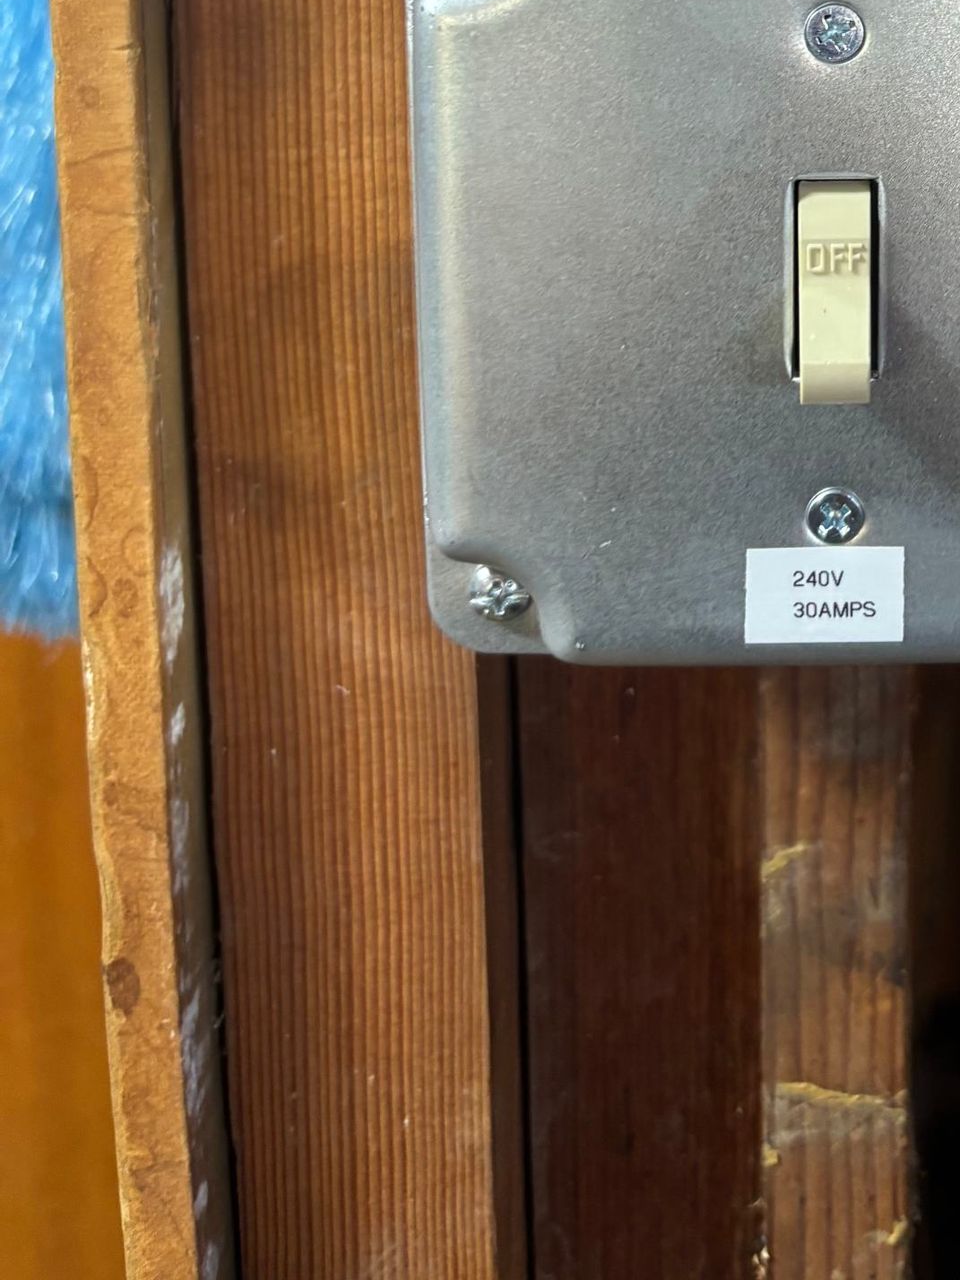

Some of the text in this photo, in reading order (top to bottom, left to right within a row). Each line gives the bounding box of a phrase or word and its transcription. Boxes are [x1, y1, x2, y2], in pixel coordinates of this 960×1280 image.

[806, 243, 867, 273] OFF
[792, 570, 845, 587] 240V
[793, 601, 877, 618] 30AMPS
